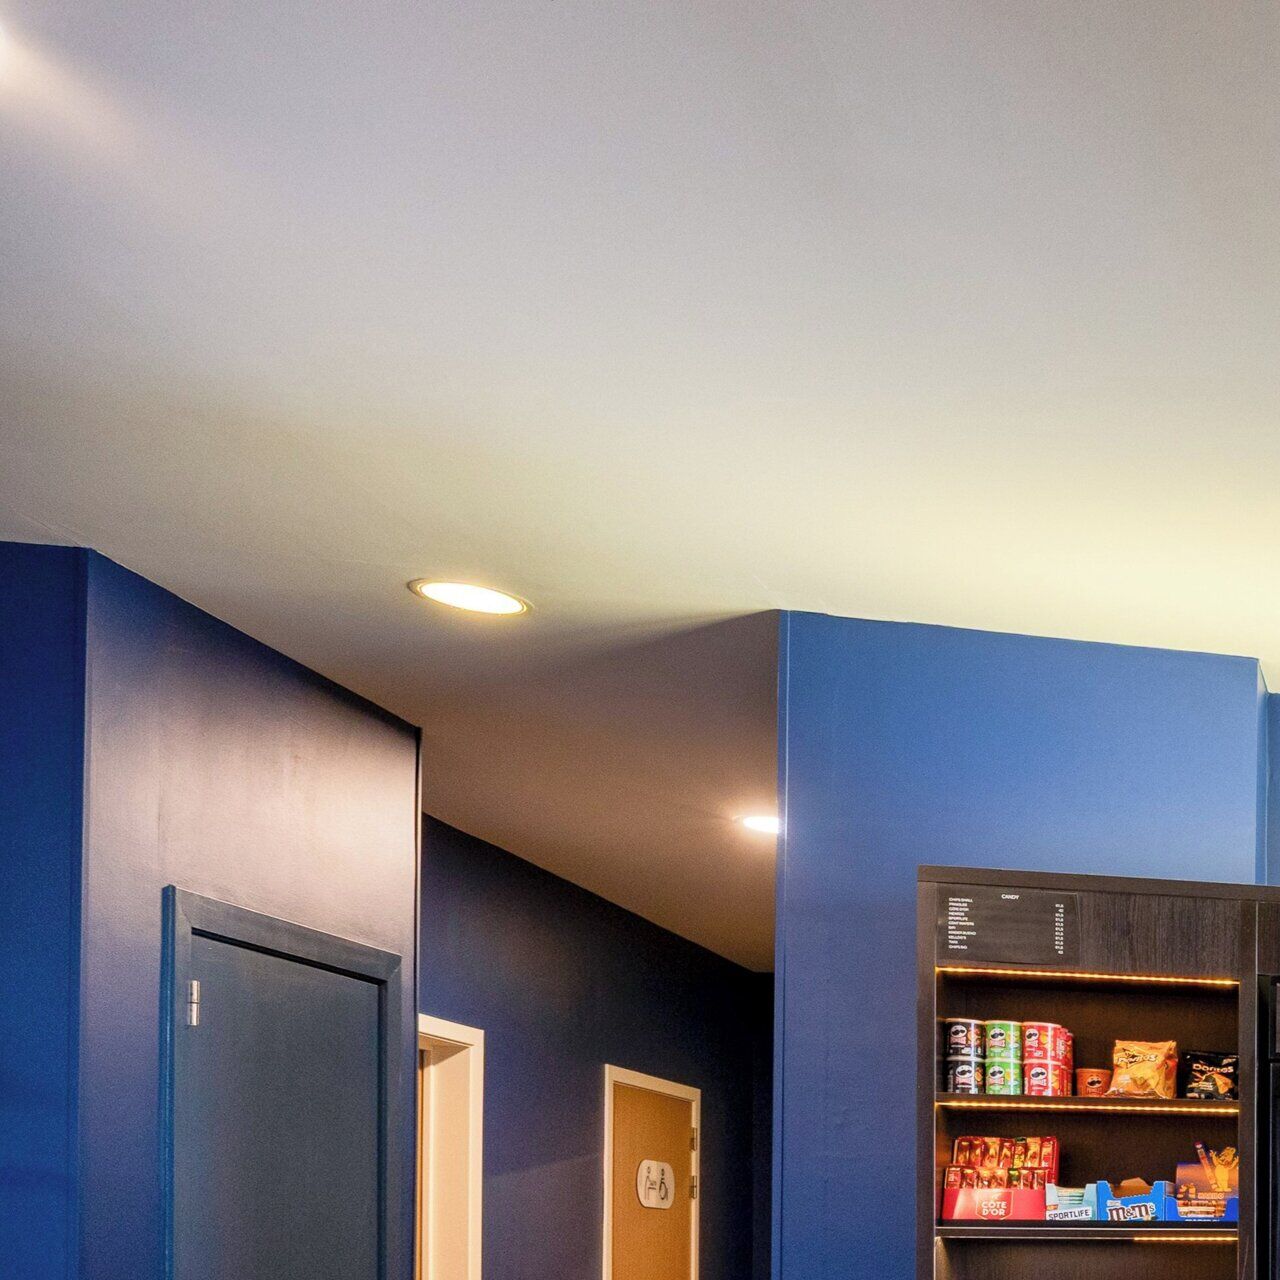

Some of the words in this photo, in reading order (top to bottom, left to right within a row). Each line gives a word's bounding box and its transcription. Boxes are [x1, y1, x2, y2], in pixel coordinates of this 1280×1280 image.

[1192, 1063, 1234, 1073] Doritos
[982, 1208, 1006, 1216] D'OR
[1048, 1208, 1090, 1220] SPORTLIFE
